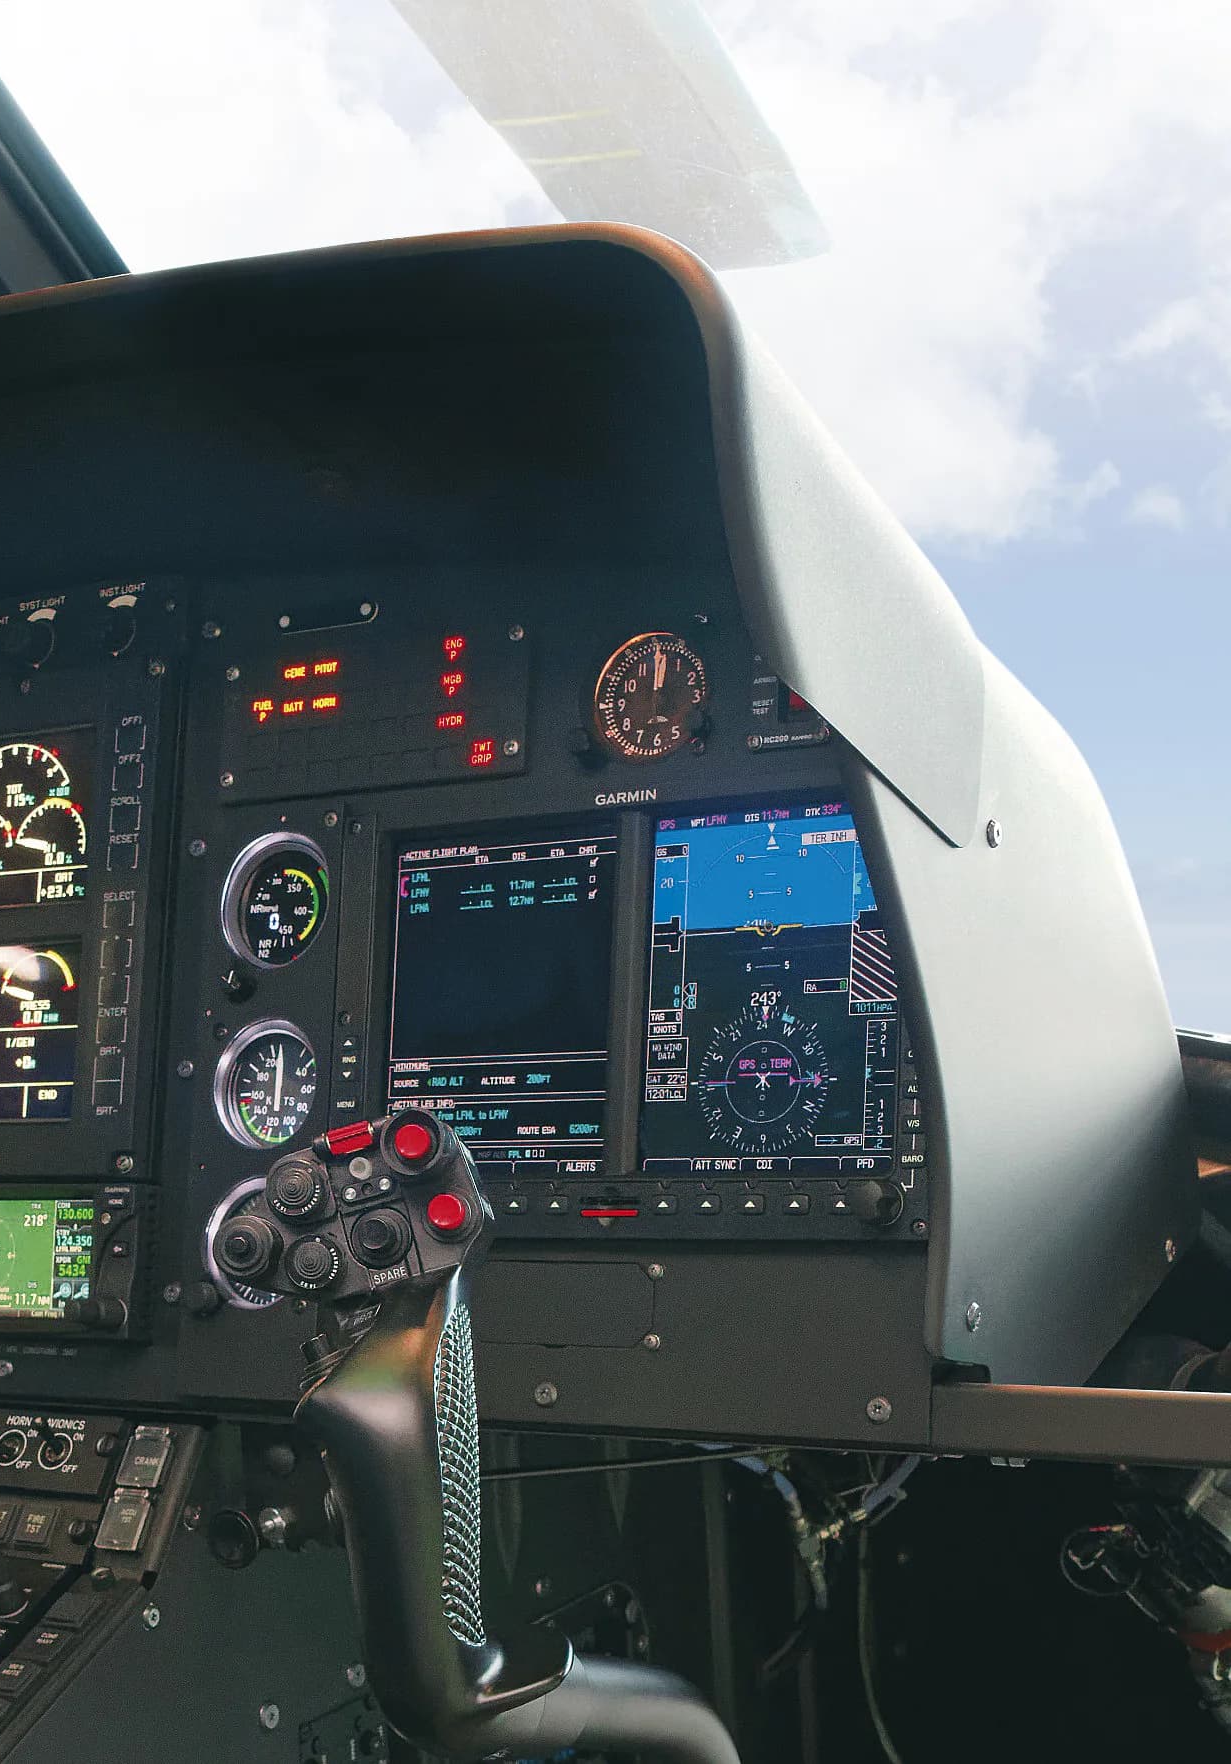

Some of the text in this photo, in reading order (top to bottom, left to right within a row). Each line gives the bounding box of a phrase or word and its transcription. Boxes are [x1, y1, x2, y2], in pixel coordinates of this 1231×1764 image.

[445, 638, 463, 650] ENG
[450, 650, 457, 661] P
[284, 661, 338, 680] GENE PITOT
[638, 662, 647, 678] 11
[443, 674, 462, 686] MGB
[687, 672, 697, 686] 2
[449, 686, 455, 697] P
[623, 679, 637, 694] 10
[253, 696, 336, 714] FUEL BATT HORN
[617, 698, 626, 712] 9
[259, 711, 267, 722] P
[753, 708, 769, 716] TEST
[121, 716, 143, 726] OFF1
[437, 714, 463, 728] HYDR
[621, 718, 631, 732] 8
[636, 730, 645, 744] 7
[671, 726, 681, 740] 5
[653, 734, 662, 747] 6
[473, 740, 492, 753] TWT
[119, 754, 141, 766] OFF2
[471, 752, 492, 766] GRIP
[111, 796, 141, 806] SCROLL
[595, 788, 657, 806] GARMIN
[659, 820, 676, 830] GPS
[691, 817, 705, 828] WPT
[745, 812, 760, 823] DIS
[805, 806, 821, 817] DTK
[109, 834, 139, 844] RESET
[811, 832, 847, 844] TER INH
[406, 850, 430, 860] ACTIVE
[433, 848, 457, 858] FLIGHT
[475, 845, 597, 864] ETA DIS ETA CHRT
[735, 848, 807, 864] 10 10
[287, 884, 302, 894] 350
[660, 878, 674, 889] 20
[103, 890, 137, 902] SELECT
[293, 906, 307, 916] 400
[279, 924, 293, 935] 450
[258, 950, 270, 959] N2
[806, 984, 817, 992] RA
[19, 1000, 51, 1011] PRESS
[98, 1006, 127, 1018] ENTER
[651, 1012, 665, 1022] TAS
[653, 1024, 677, 1034] KNOTS
[783, 1024, 794, 1036] W
[664, 1042, 682, 1052] WIND
[802, 1042, 815, 1056] 30
[657, 1052, 675, 1060] DATA
[395, 1062, 429, 1071] MINIMUMS
[739, 1058, 792, 1070] GPS TERM
[257, 1072, 269, 1082] 180
[295, 1068, 307, 1077] 40
[393, 1080, 419, 1088] SOURCE
[431, 1077, 447, 1087] RAD
[449, 1076, 465, 1086] ALT
[481, 1076, 516, 1086] ALTITUDE
[37, 1089, 57, 1100] END
[251, 1090, 265, 1100] 160
[301, 1085, 312, 1094] 60
[253, 1105, 267, 1114] 140
[297, 1102, 307, 1112] 80
[437, 1110, 487, 1120] from to
[267, 1117, 279, 1126] 120
[283, 1116, 297, 1126] 100
[907, 1119, 920, 1128] V/S
[517, 1126, 539, 1135] ROUTE
[541, 1125, 557, 1134] ESA
[843, 1136, 860, 1146] GPS
[507, 1150, 522, 1159] FPL
[901, 1154, 923, 1163] BARO
[565, 1162, 597, 1172] ALERTS
[695, 1160, 737, 1170] ATT SYNC
[756, 1160, 773, 1170] CDI
[857, 1158, 875, 1169] PFD
[58, 1208, 94, 1220] 130.600
[56, 1235, 93, 1247] 124.350
[58, 1264, 86, 1278] 5434
[373, 1266, 407, 1285] SPARE
[7, 1415, 33, 1426] HORN
[47, 1418, 85, 1430] AVIONICS
[27, 1429, 39, 1438] ON
[73, 1432, 85, 1441] ON
[15, 1460, 32, 1470] OFF
[61, 1464, 78, 1474] OFF
[26, 1524, 41, 1534] TST
